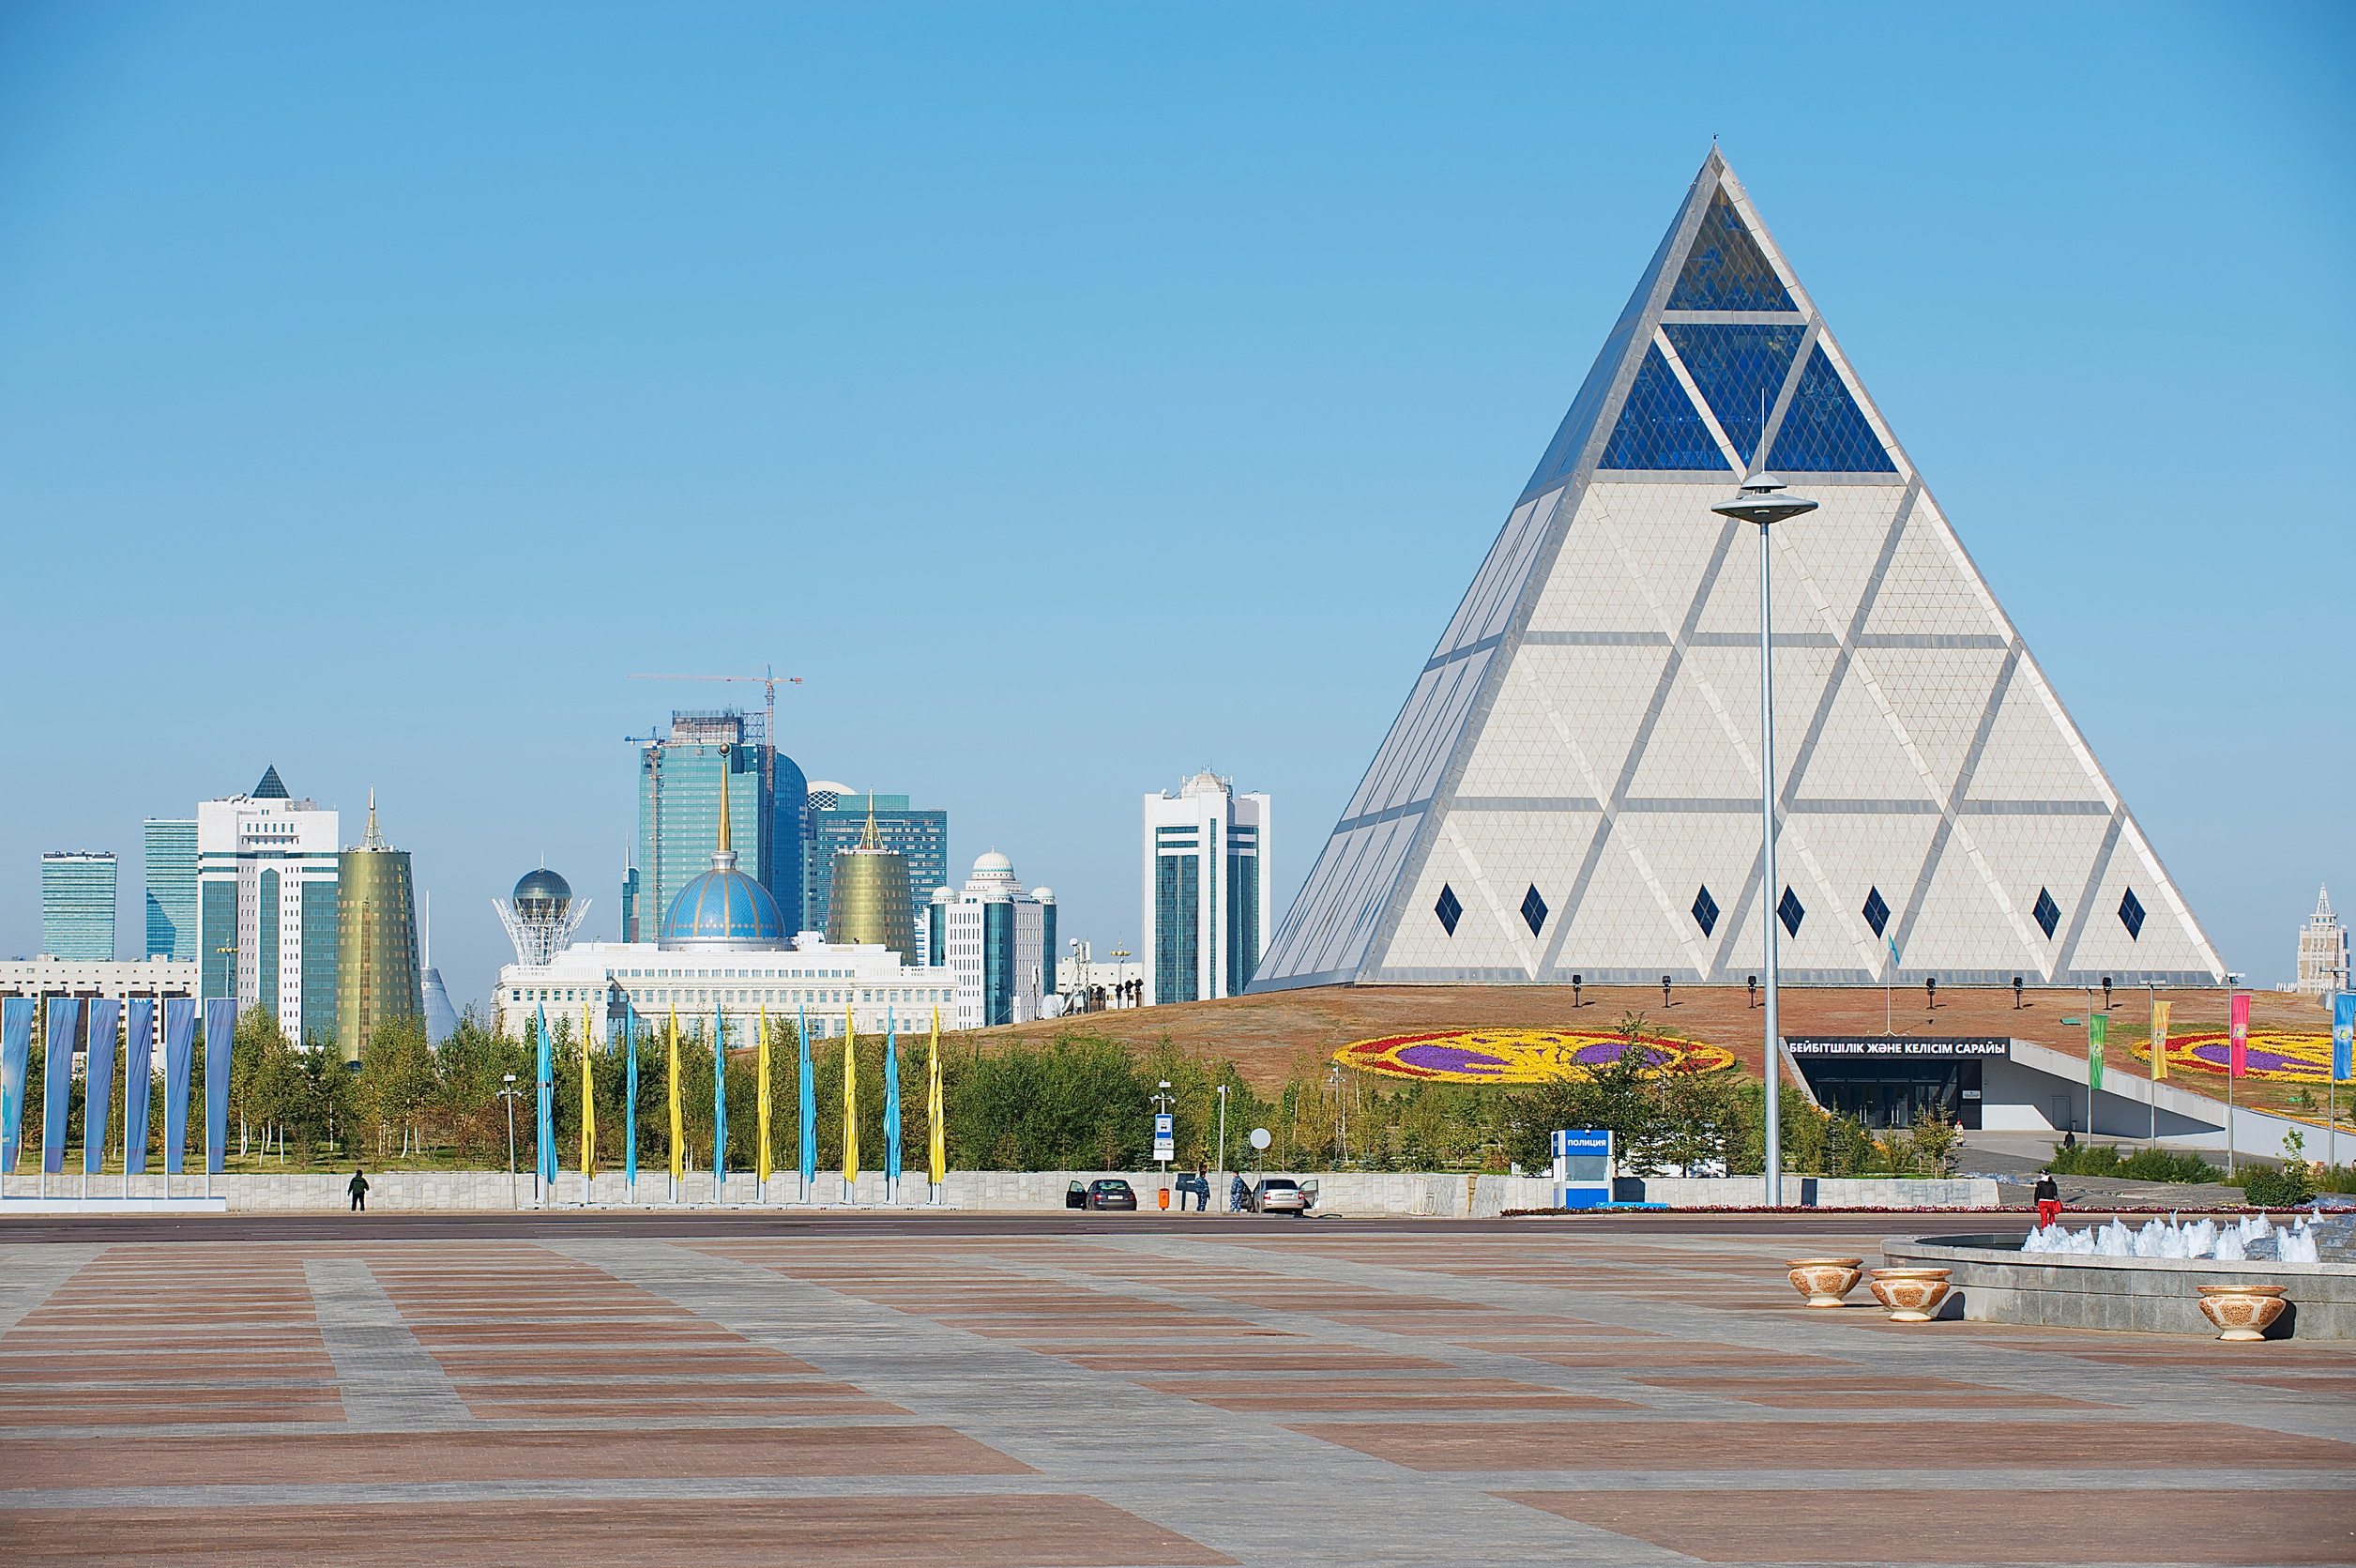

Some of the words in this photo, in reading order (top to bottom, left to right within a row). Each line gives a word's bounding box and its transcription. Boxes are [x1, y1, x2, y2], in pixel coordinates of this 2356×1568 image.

[1789, 1040, 1864, 1053] БЕЙБІТШІЛІК
[1866, 1043, 1902, 1053] ЖӘНЕ
[1905, 1043, 1953, 1053] КЕЛІСІМ
[1955, 1041, 2005, 1053] САРАЙЫ
